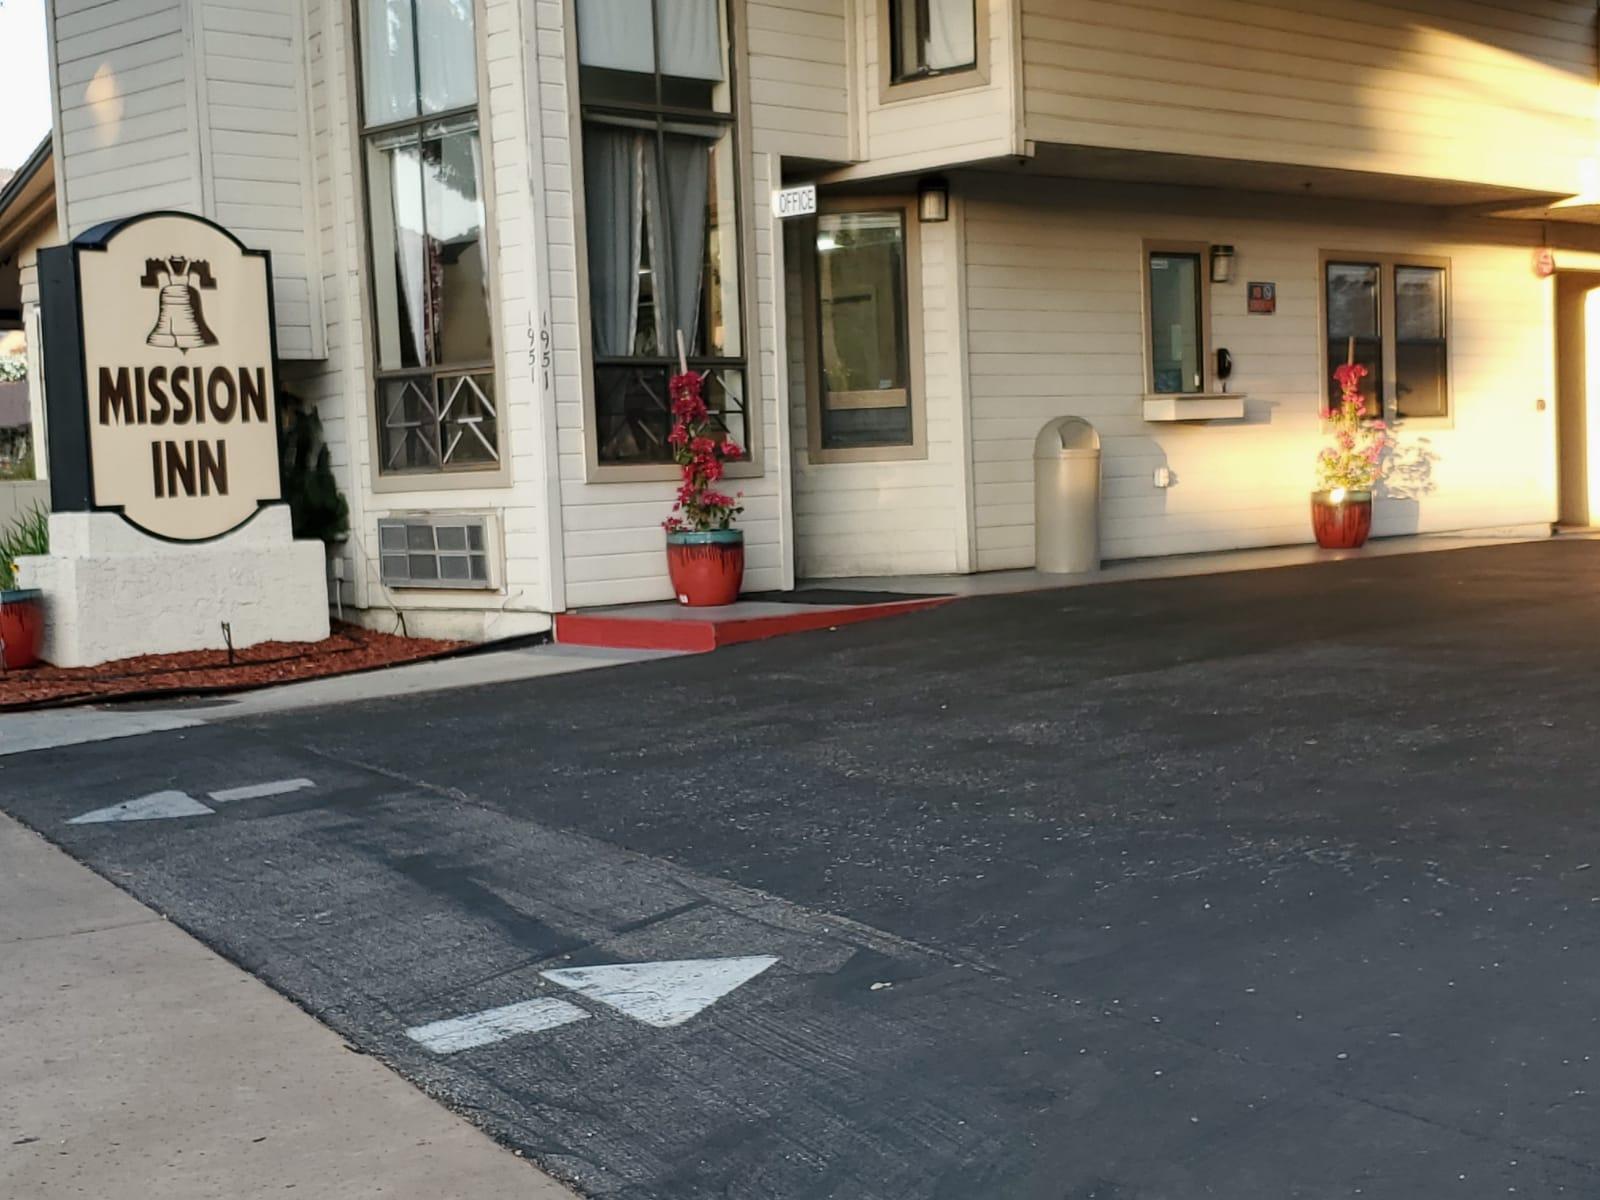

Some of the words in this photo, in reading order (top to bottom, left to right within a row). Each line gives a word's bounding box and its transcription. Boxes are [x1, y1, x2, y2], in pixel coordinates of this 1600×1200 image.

[780, 190, 814, 213] OFFICE
[527, 310, 536, 384] 1951
[540, 310, 551, 391] 1951
[99, 366, 268, 426] MISSION
[152, 439, 229, 499] INN
